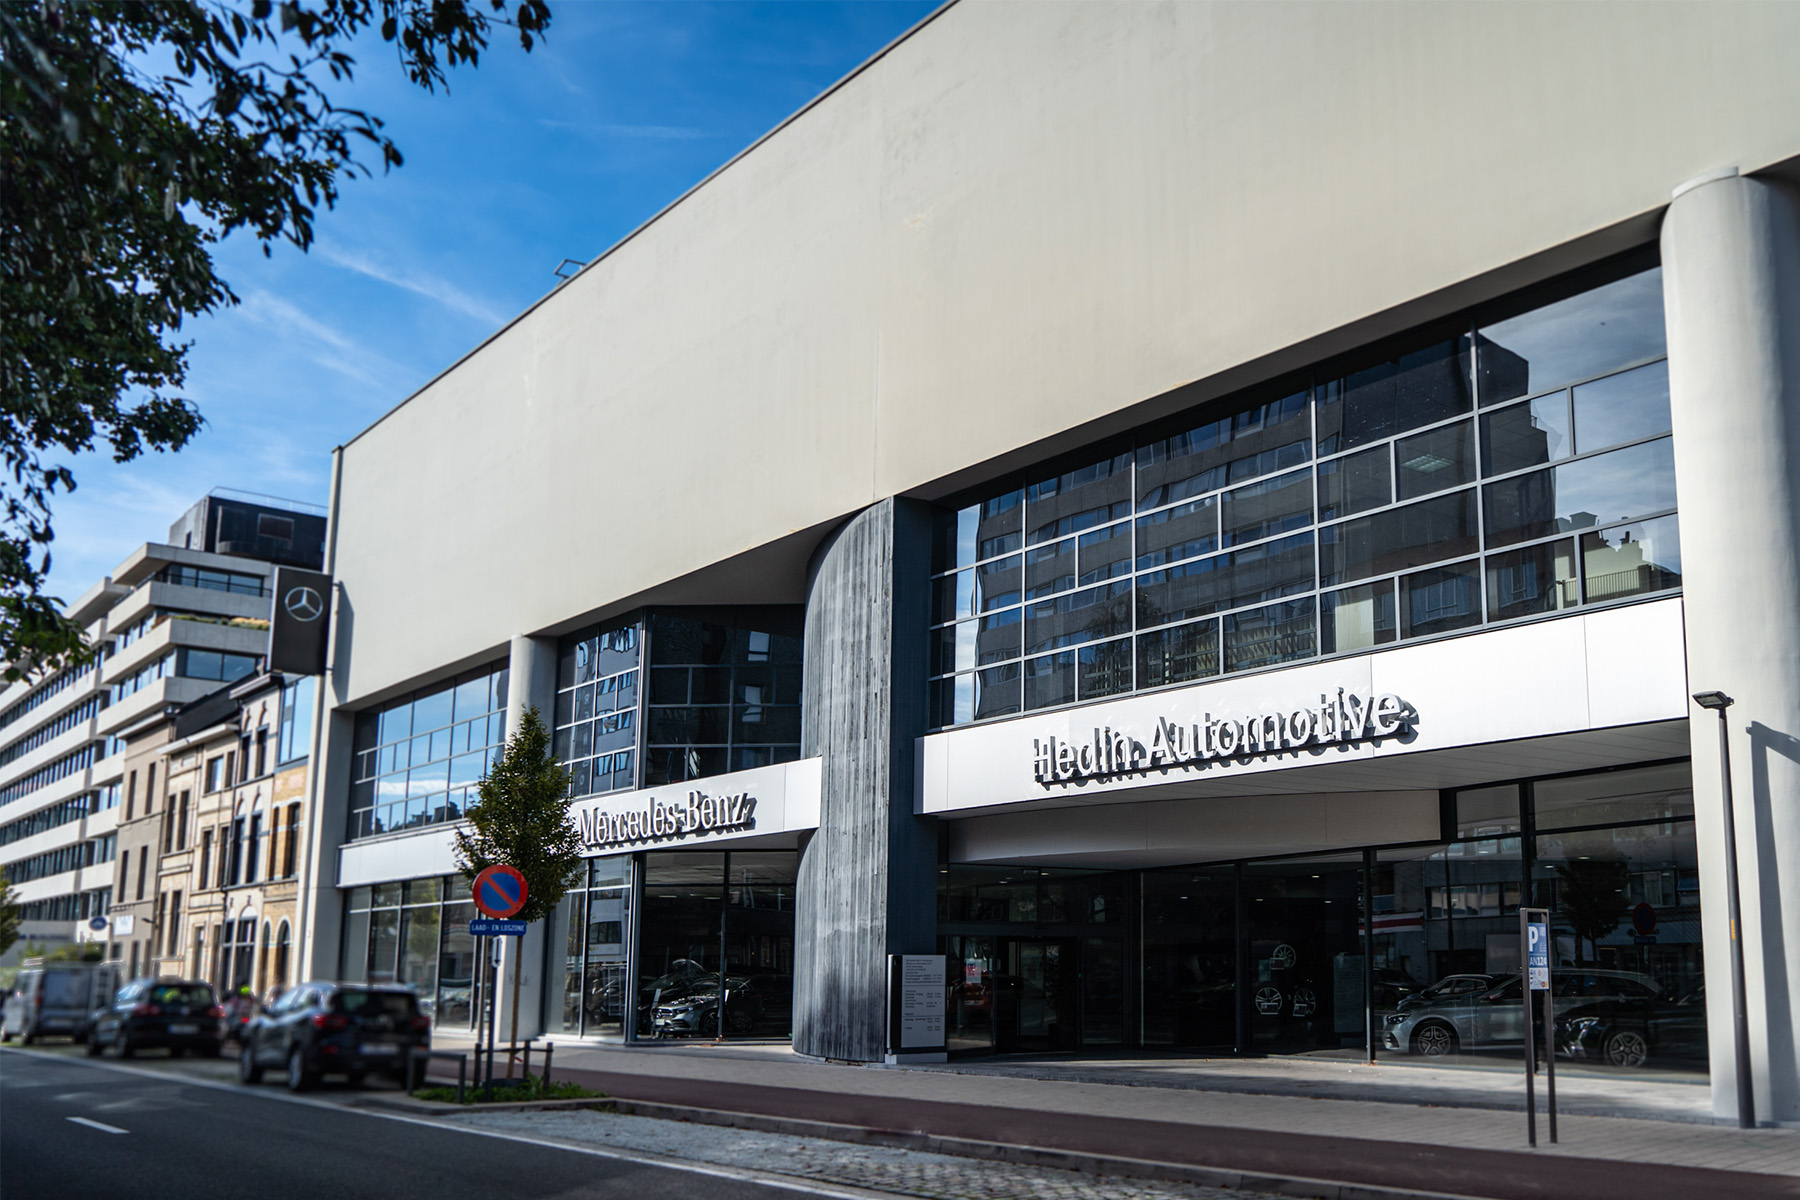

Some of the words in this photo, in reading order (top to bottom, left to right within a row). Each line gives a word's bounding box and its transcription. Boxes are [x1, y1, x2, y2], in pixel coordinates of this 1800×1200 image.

[1033, 726, 1135, 782] Hedin
[1146, 687, 1408, 767] Automotive
[579, 790, 752, 846] Mercedes-Benz
[1528, 926, 1538, 952] P
[1530, 956, 1547, 966] AN124
